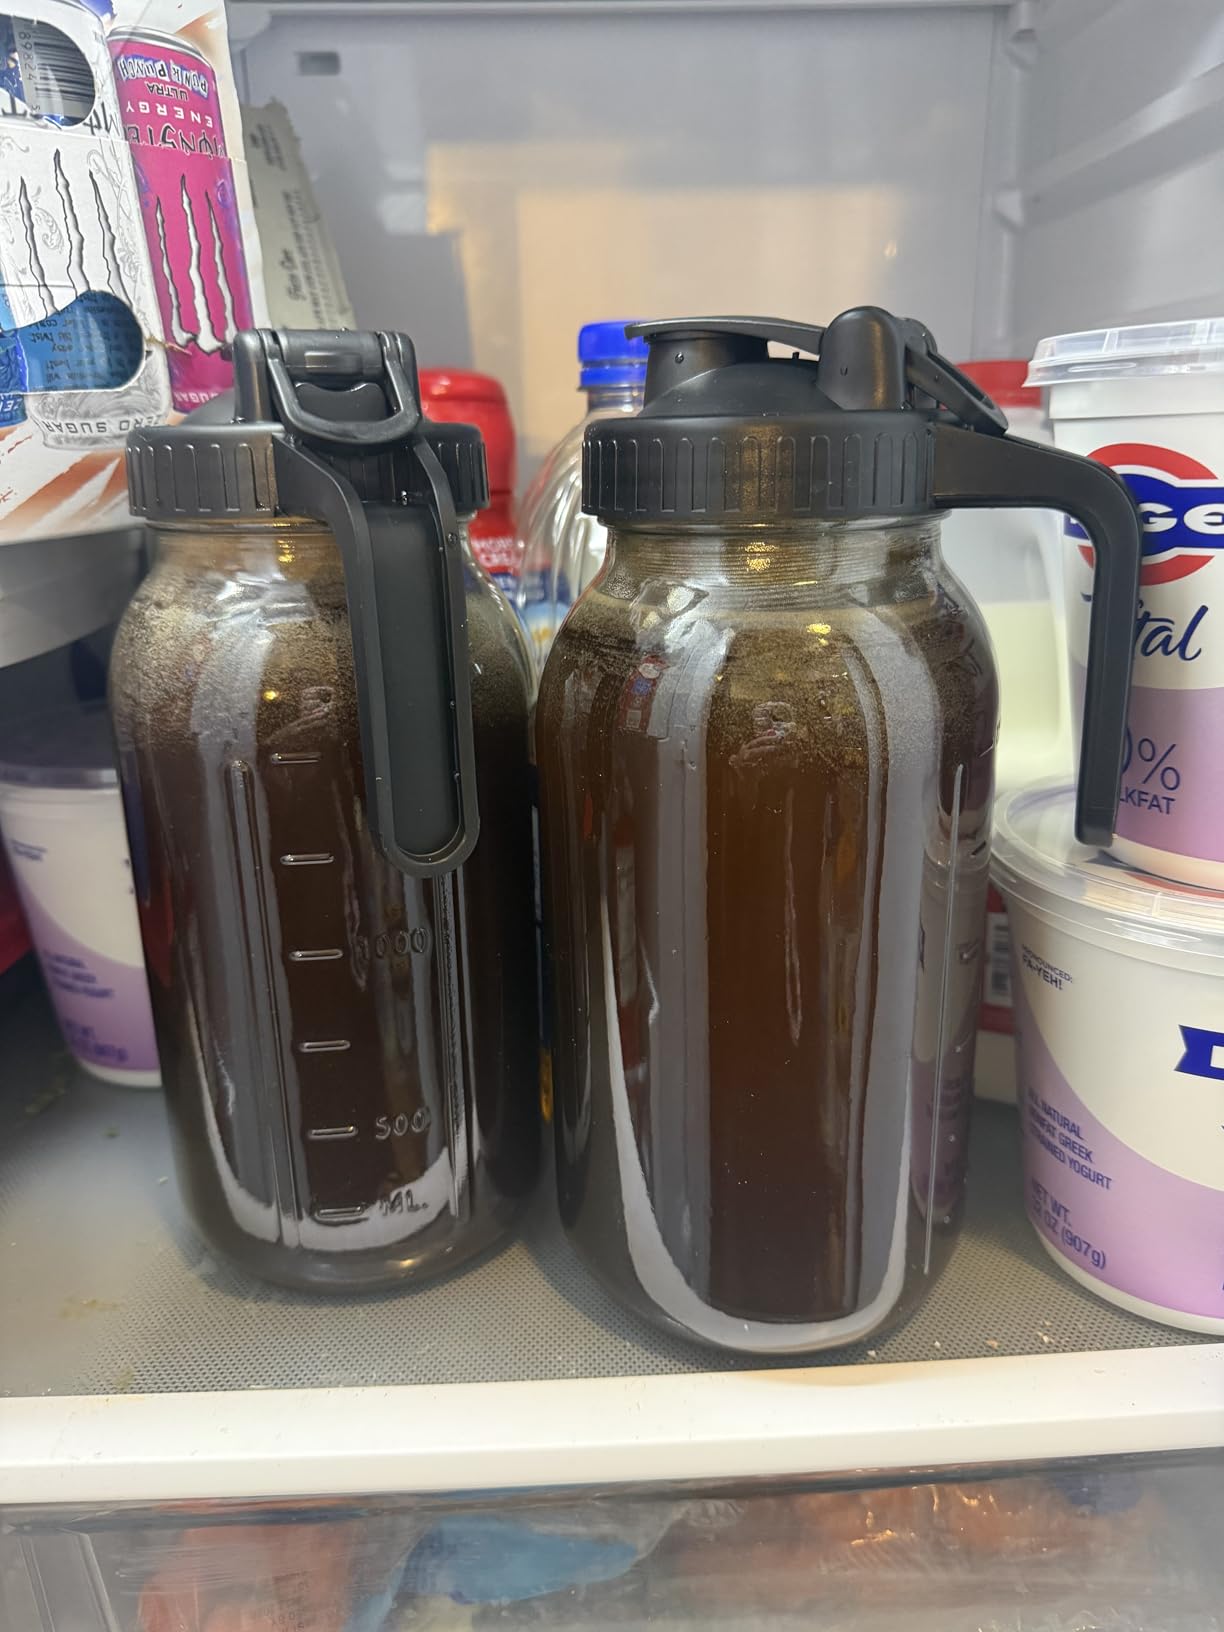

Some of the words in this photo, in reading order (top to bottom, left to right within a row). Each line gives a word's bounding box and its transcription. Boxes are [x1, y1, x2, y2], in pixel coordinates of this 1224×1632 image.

[146, 82, 188, 100] ULTRA
[126, 101, 213, 128] ENERGY
[122, 123, 228, 158] MONSTE
[0, 398, 22, 411] ZE
[43, 420, 107, 433] SUGAR
[1137, 502, 1224, 535] GE
[1120, 786, 1176, 815] KFAT
[375, 1108, 429, 1140] 500
[1041, 1100, 1085, 1141] NATURAL
[1059, 1132, 1094, 1164] GREEK
[1067, 1155, 1112, 1190] YOGURT
[1061, 1226, 1106, 1270] (907g)
